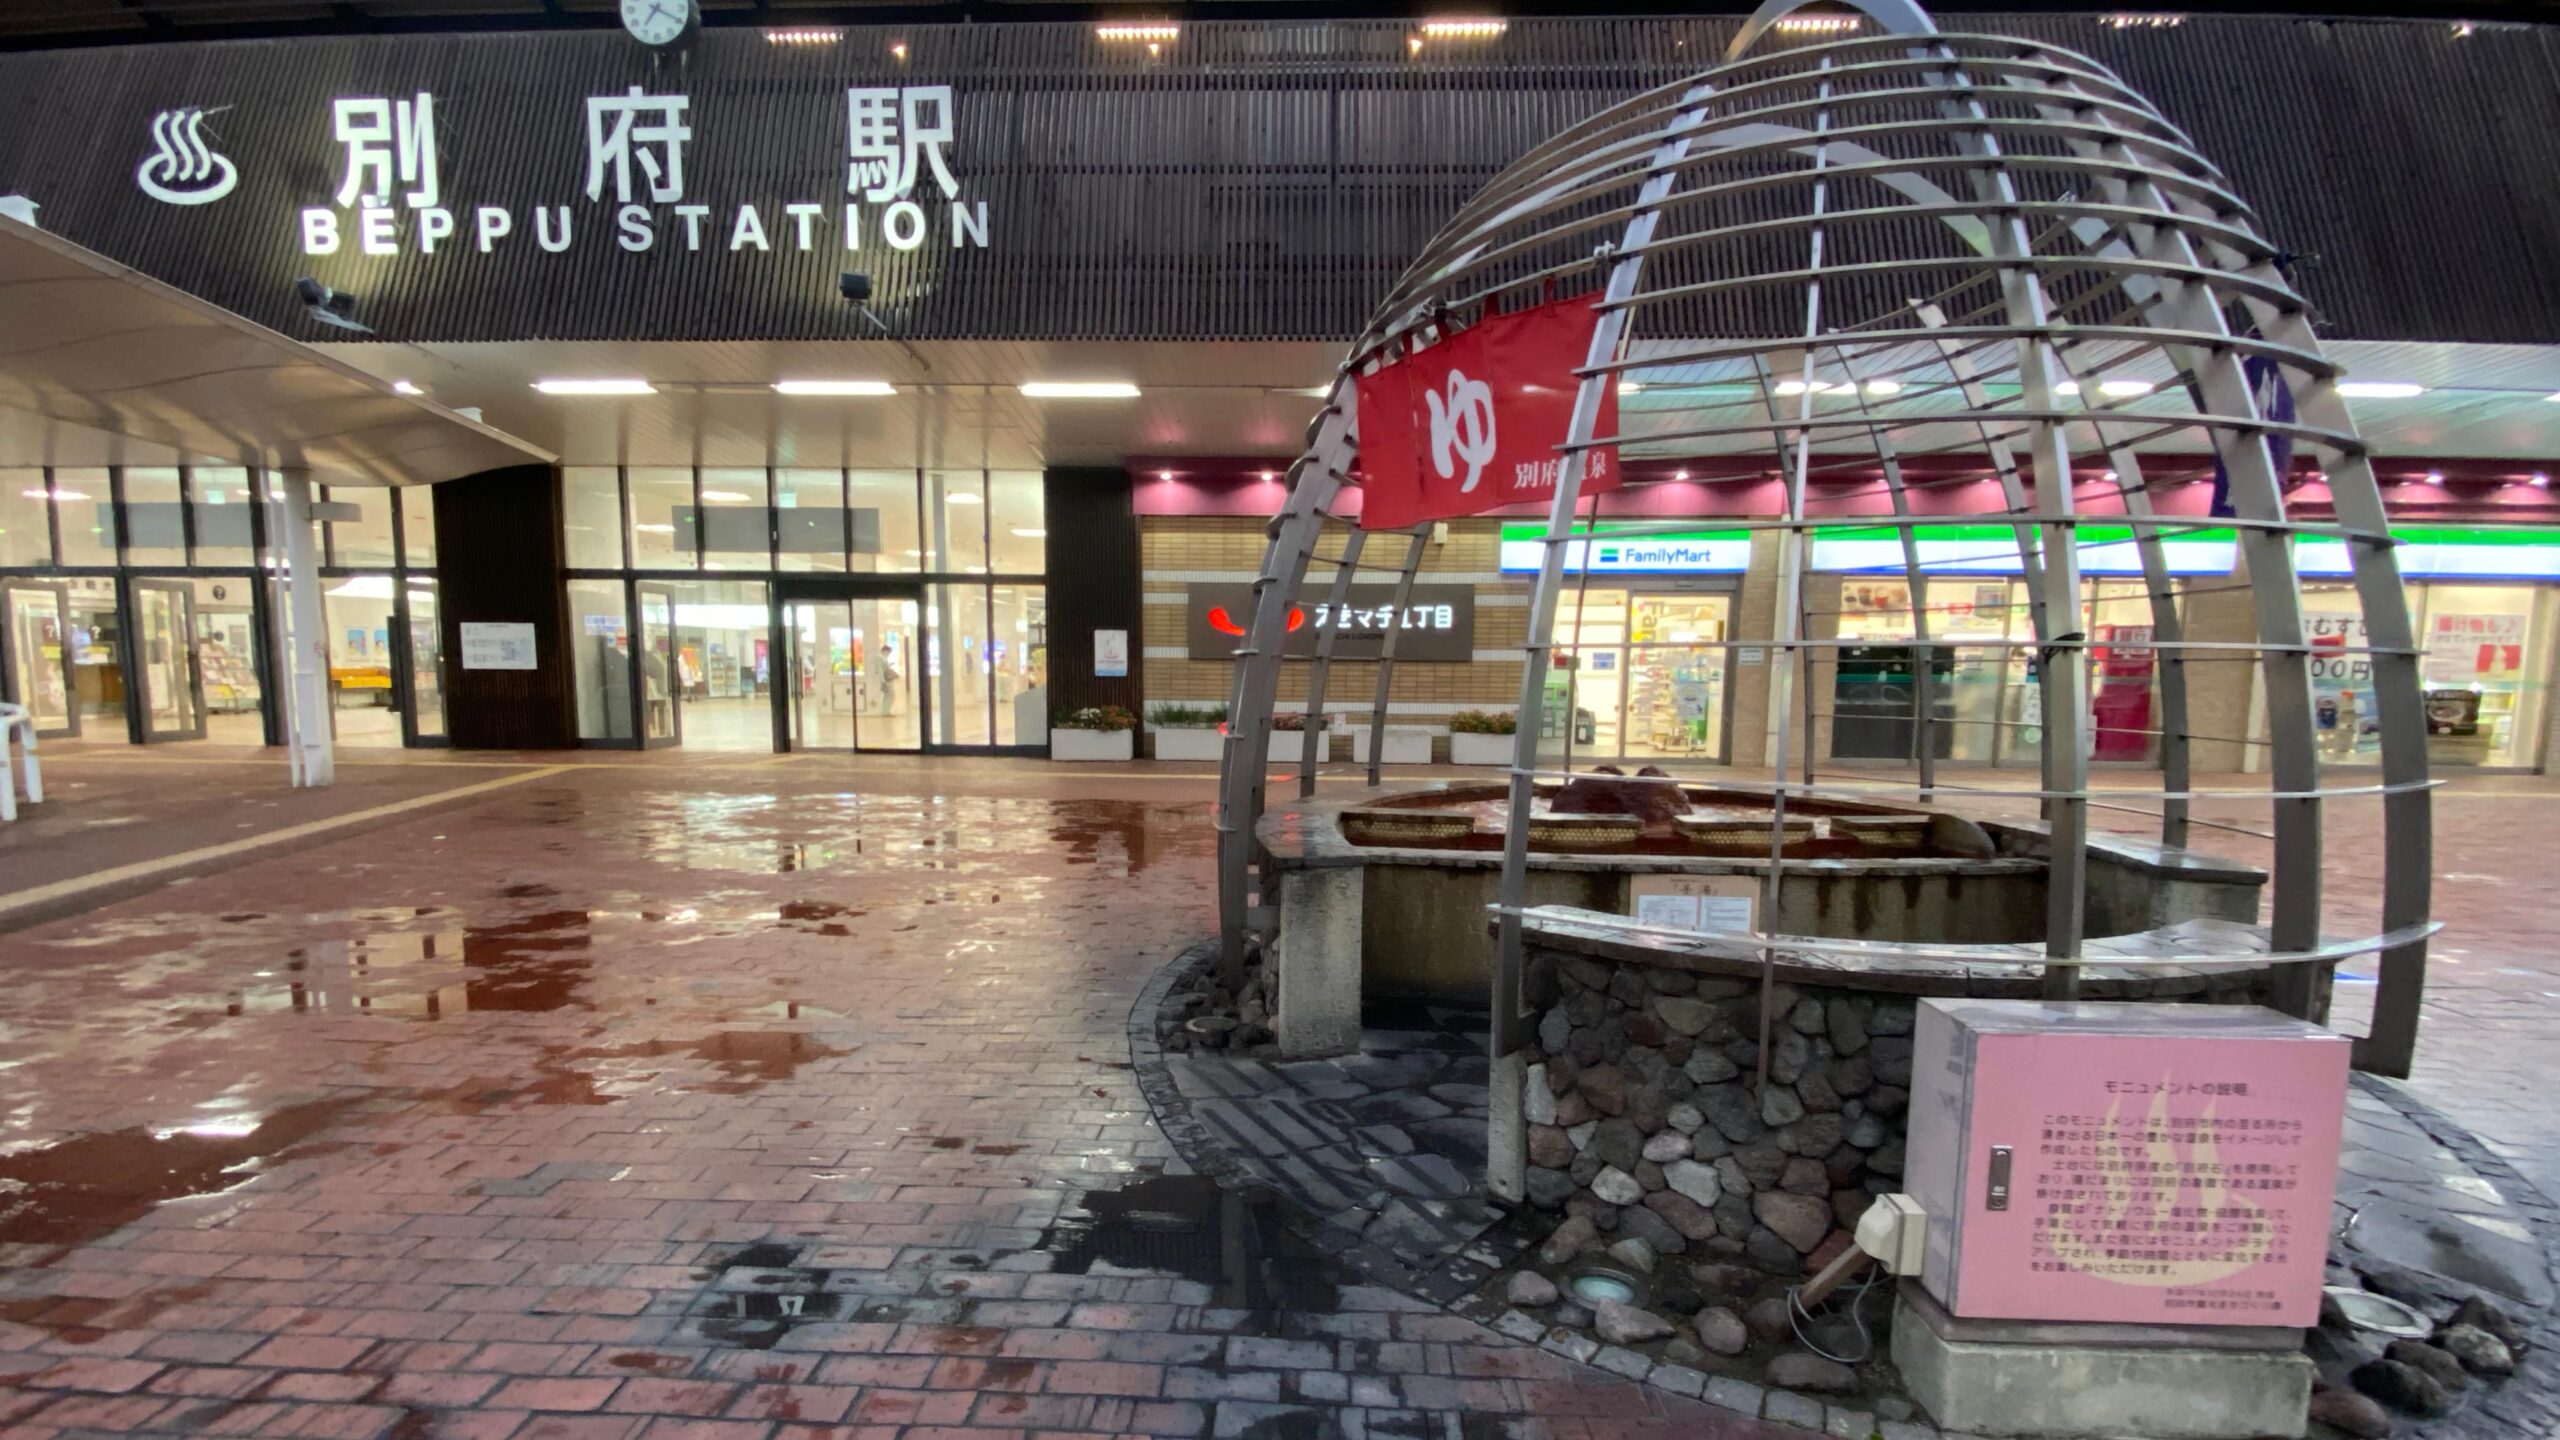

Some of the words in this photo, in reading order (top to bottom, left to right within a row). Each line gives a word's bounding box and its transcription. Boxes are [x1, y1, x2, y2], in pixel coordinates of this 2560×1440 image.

[333, 86, 959, 208] 別府駅
[302, 205, 572, 255] BEPPU
[617, 201, 990, 253] STATION
[1425, 368, 1497, 493] ゆ
[1513, 450, 1607, 491] 別府泉
[1625, 547, 1712, 566] FamilyMart
